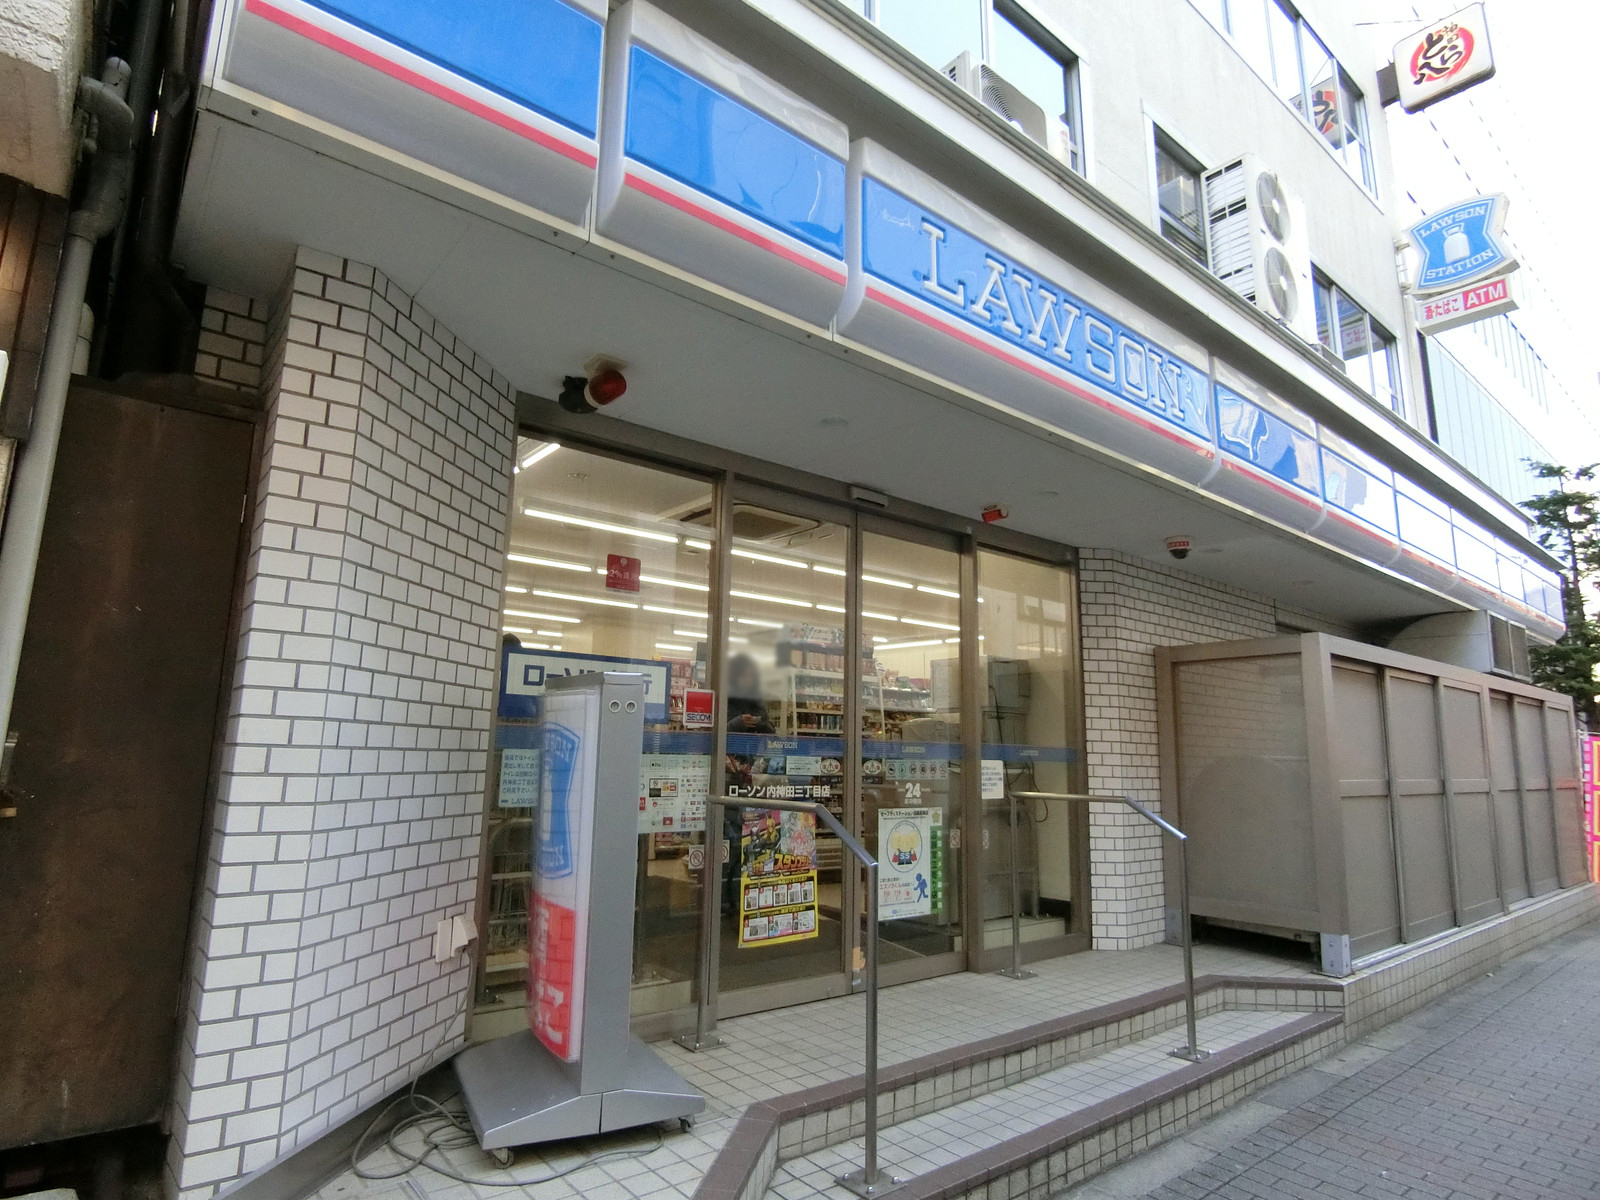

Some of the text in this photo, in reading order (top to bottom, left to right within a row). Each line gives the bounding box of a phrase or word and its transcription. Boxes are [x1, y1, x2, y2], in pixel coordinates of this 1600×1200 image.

[1420, 205, 1486, 238] LAWSON
[1425, 248, 1494, 280] STATION
[1466, 282, 1504, 308] ATM
[920, 220, 1185, 420] LAWSON
[686, 713, 711, 722] SECOM
[767, 741, 798, 749] LAWSON
[728, 784, 831, 798] ローソン内神田三丁目店
[904, 782, 922, 798] 24
[899, 852, 910, 860] SS
